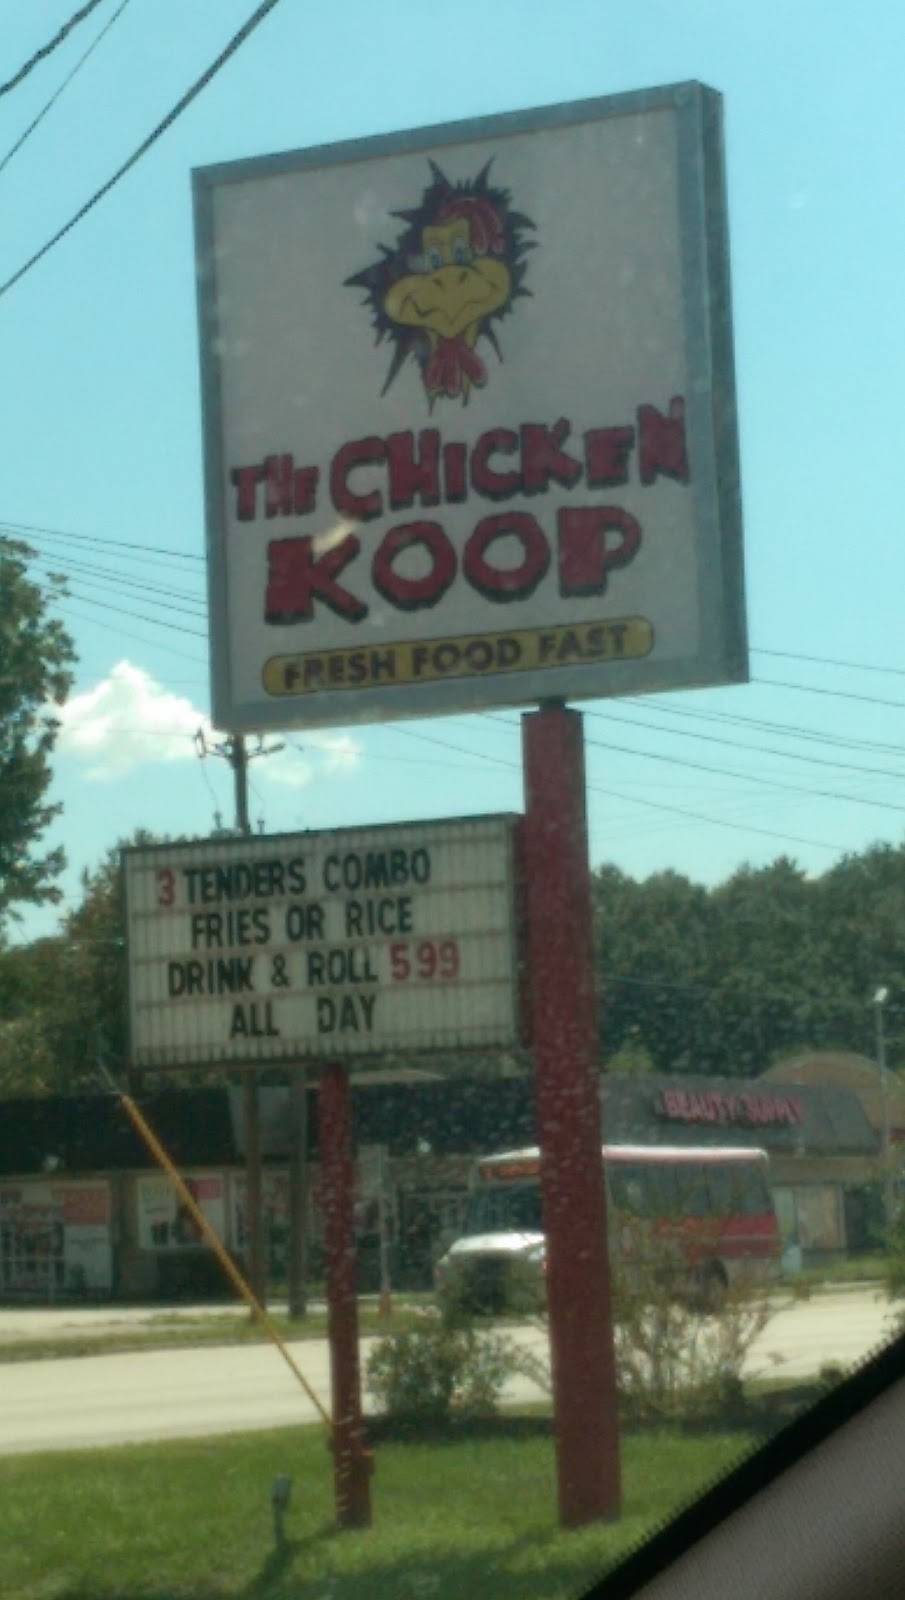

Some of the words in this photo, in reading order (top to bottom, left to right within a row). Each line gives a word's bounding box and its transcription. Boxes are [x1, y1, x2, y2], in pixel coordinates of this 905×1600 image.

[230, 453, 319, 521] THE
[329, 395, 689, 521] CHICKEN
[265, 506, 642, 625] KOOP
[284, 652, 396, 691] FRESH
[413, 637, 523, 676] FOOD
[538, 625, 630, 660] FAST
[157, 868, 176, 907] 3
[183, 858, 307, 905] TENDERS
[323, 847, 431, 892] COMBO
[192, 906, 270, 949] FRIES
[286, 902, 325, 942] OR
[345, 895, 414, 938] RICE
[168, 955, 254, 997] DRINK
[271, 953, 291, 987] &
[307, 948, 379, 988] ROLL
[390, 939, 461, 981] 599
[230, 1002, 279, 1039] ALL
[316, 995, 377, 1034] DAY
